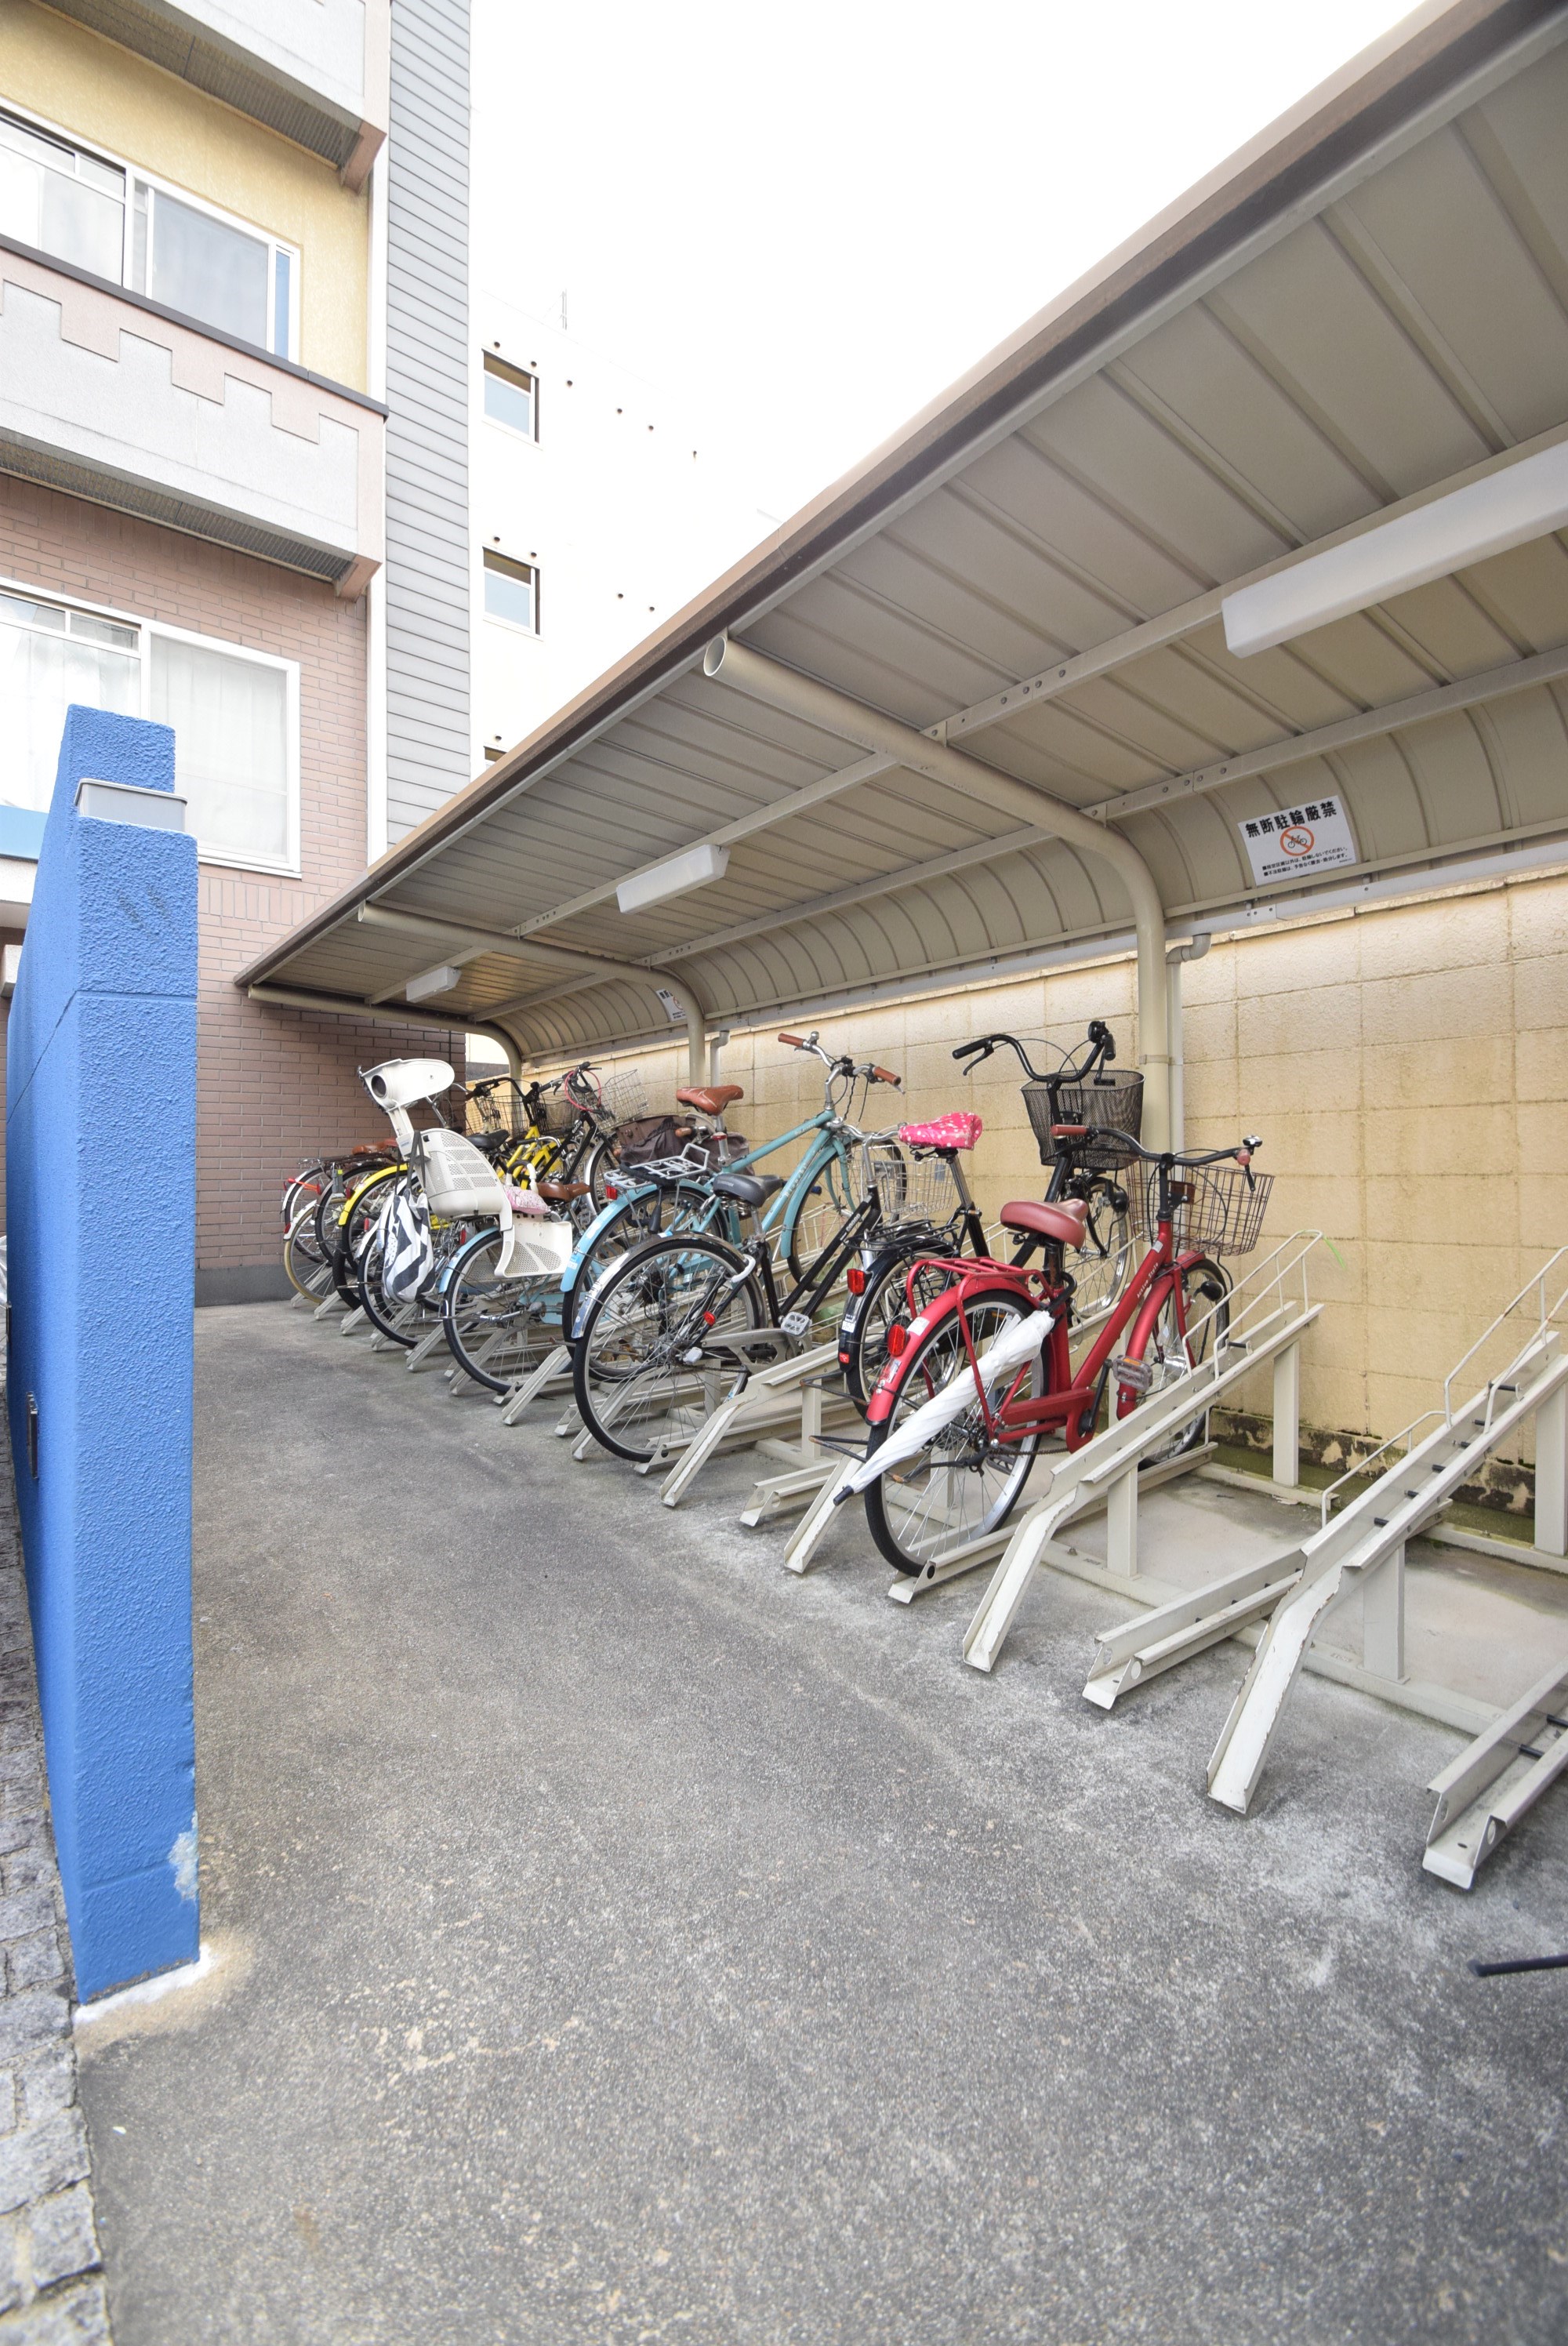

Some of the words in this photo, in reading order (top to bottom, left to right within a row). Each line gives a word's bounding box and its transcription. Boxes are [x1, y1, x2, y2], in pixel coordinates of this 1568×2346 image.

[1245, 801, 1338, 838] 無断駐輪厳禁
